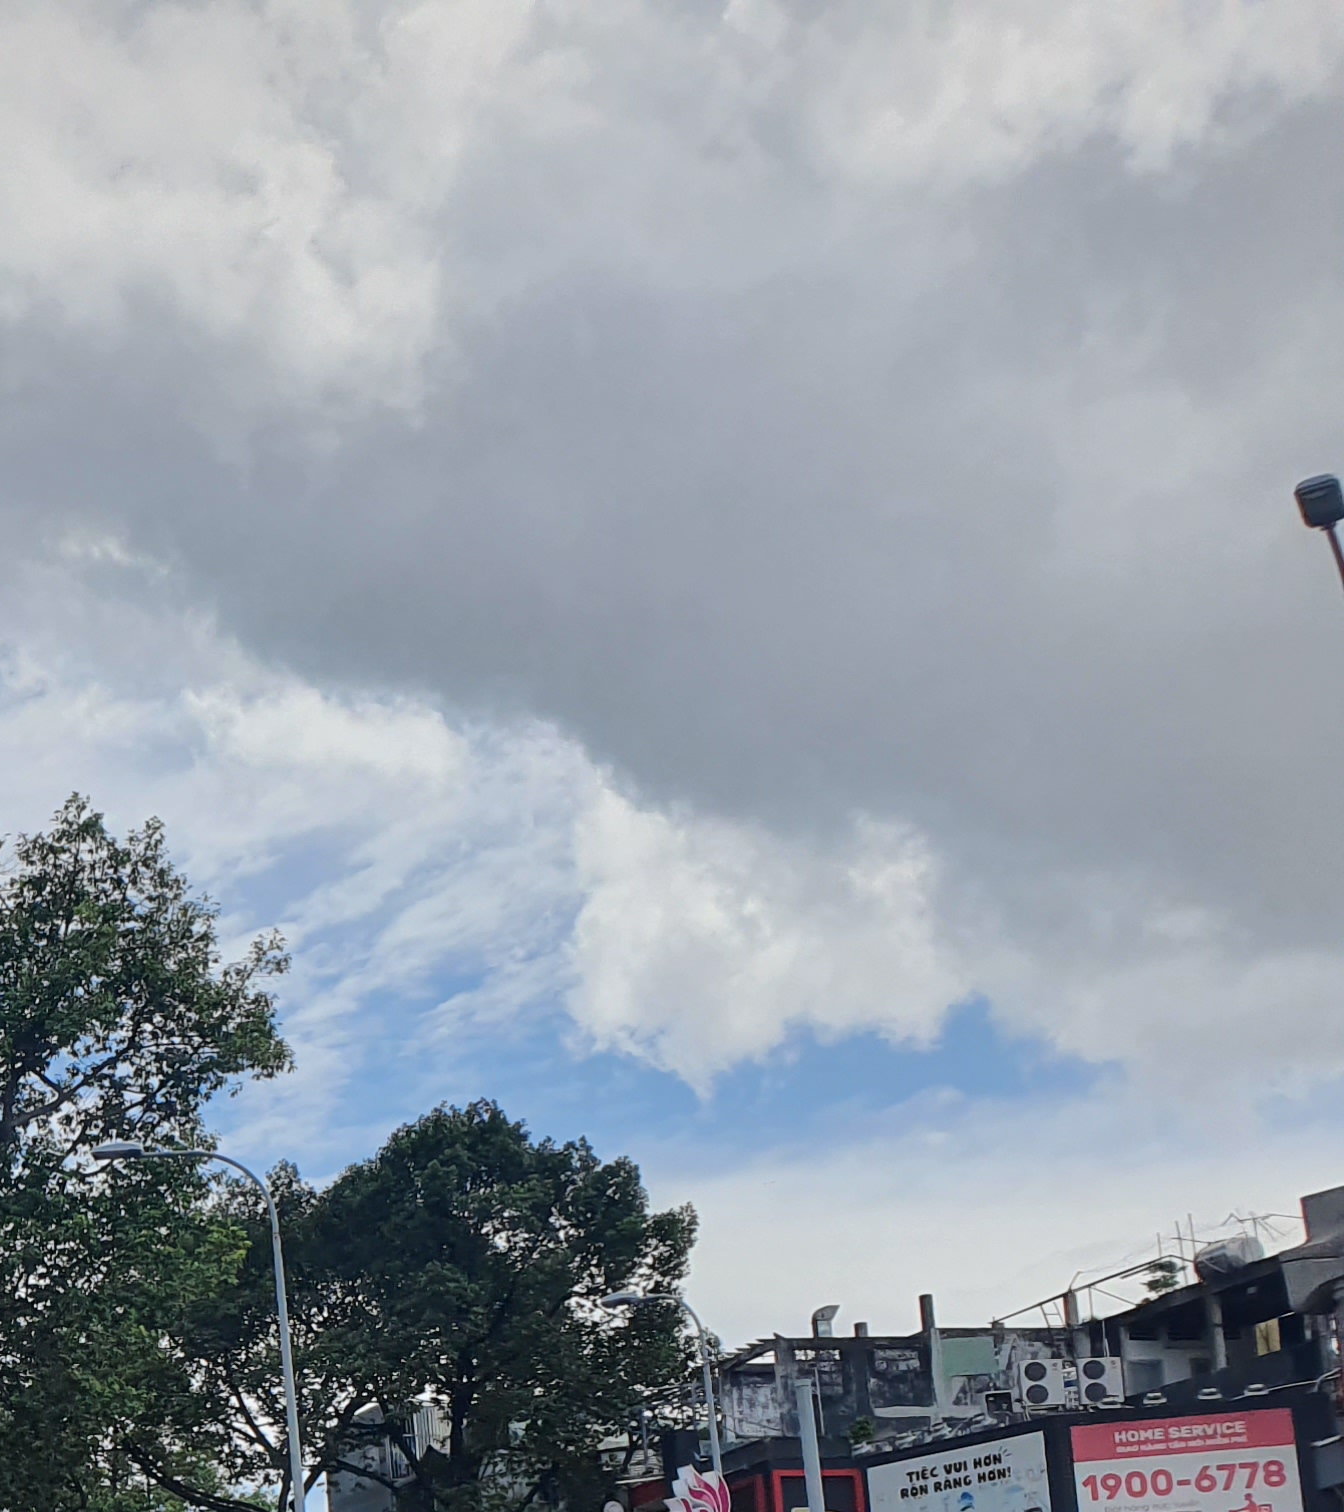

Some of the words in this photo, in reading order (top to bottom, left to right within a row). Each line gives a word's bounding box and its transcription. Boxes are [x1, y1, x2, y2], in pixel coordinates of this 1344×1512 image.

[1114, 1428, 1165, 1443] HOME
[1168, 1421, 1247, 1439] SERVICE
[944, 1461, 968, 1475] VUI
[1082, 1459, 1287, 1502] 1900-6778
